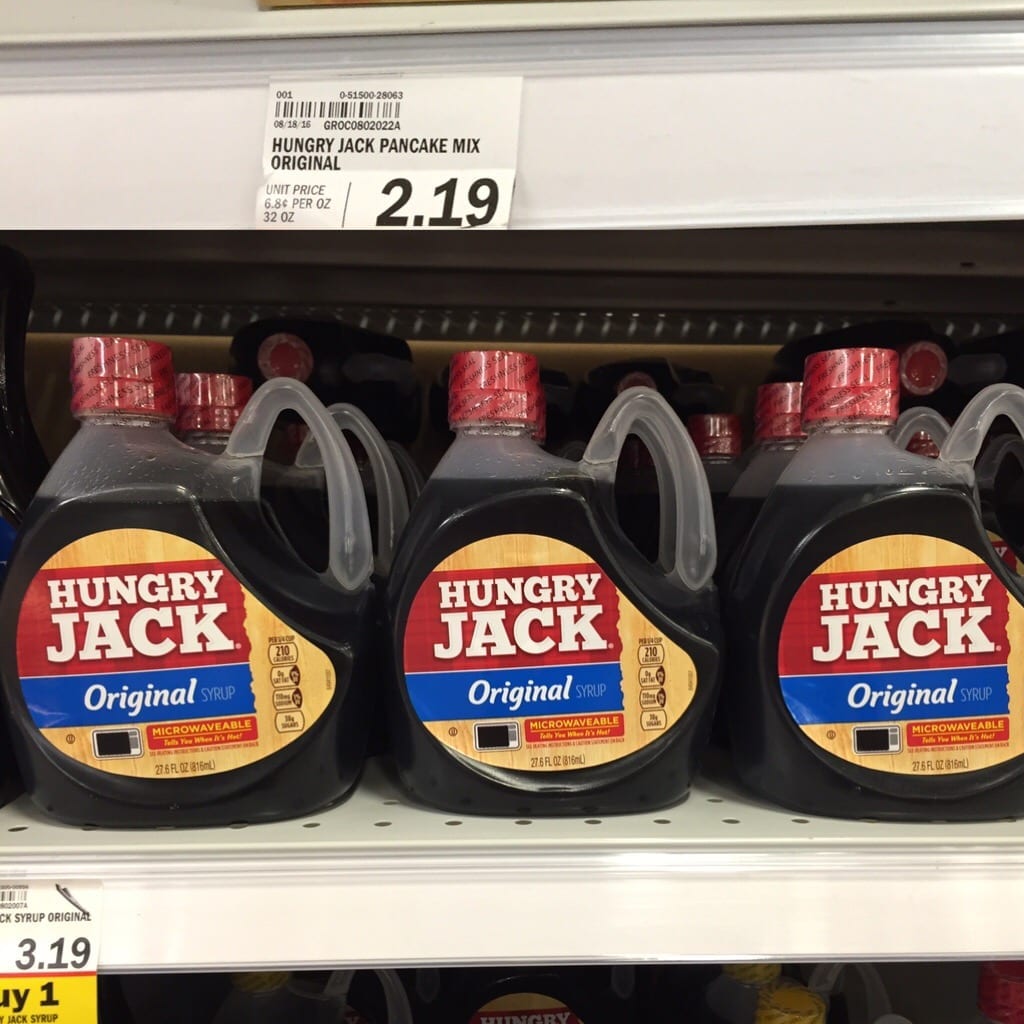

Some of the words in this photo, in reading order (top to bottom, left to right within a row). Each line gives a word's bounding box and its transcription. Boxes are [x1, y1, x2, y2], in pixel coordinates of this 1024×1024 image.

[276, 91, 293, 99] 001
[339, 91, 404, 100] 0-51500-28063
[323, 121, 401, 131] GROC0802022A
[272, 137, 335, 153] HUNGRY
[337, 138, 375, 153] JACK
[379, 138, 449, 153] PANCAKE
[452, 138, 481, 154] MIX
[271, 155, 341, 170] ORIGINAL
[266, 184, 291, 195] UNIT
[292, 184, 326, 195] PRICE
[264, 198, 288, 209] 6.8¢
[292, 198, 314, 209] PER
[316, 198, 332, 210] OZ
[375, 177, 500, 228] 2.19
[263, 211, 278, 222] 32
[280, 212, 295, 222] OZ
[47, 569, 224, 609] HUNGRY
[438, 573, 602, 609] HUNGRY
[819, 574, 992, 612] HUNGRY
[46, 603, 235, 663] JACK
[433, 604, 608, 659] JACK
[812, 606, 995, 662] JACK
[84, 678, 198, 717] Original
[201, 686, 236, 702] SYRUP
[468, 675, 573, 711] Original
[576, 683, 607, 698] SYRUP
[847, 678, 958, 715] Original
[960, 687, 993, 703] SYRUP
[152, 719, 252, 736] MICROWAVEABLE
[529, 716, 620, 729] MICROWAVEABLE
[912, 720, 1005, 734] MICROWAVEABLE
[15, 914, 45, 923] SYRUP
[48, 912, 92, 922] ORIGINAL
[15, 937, 91, 970] 3.19
[40, 982, 59, 1006] 1
[8, 1015, 28, 1024] JACK
[30, 1014, 59, 1024] SYRUP
